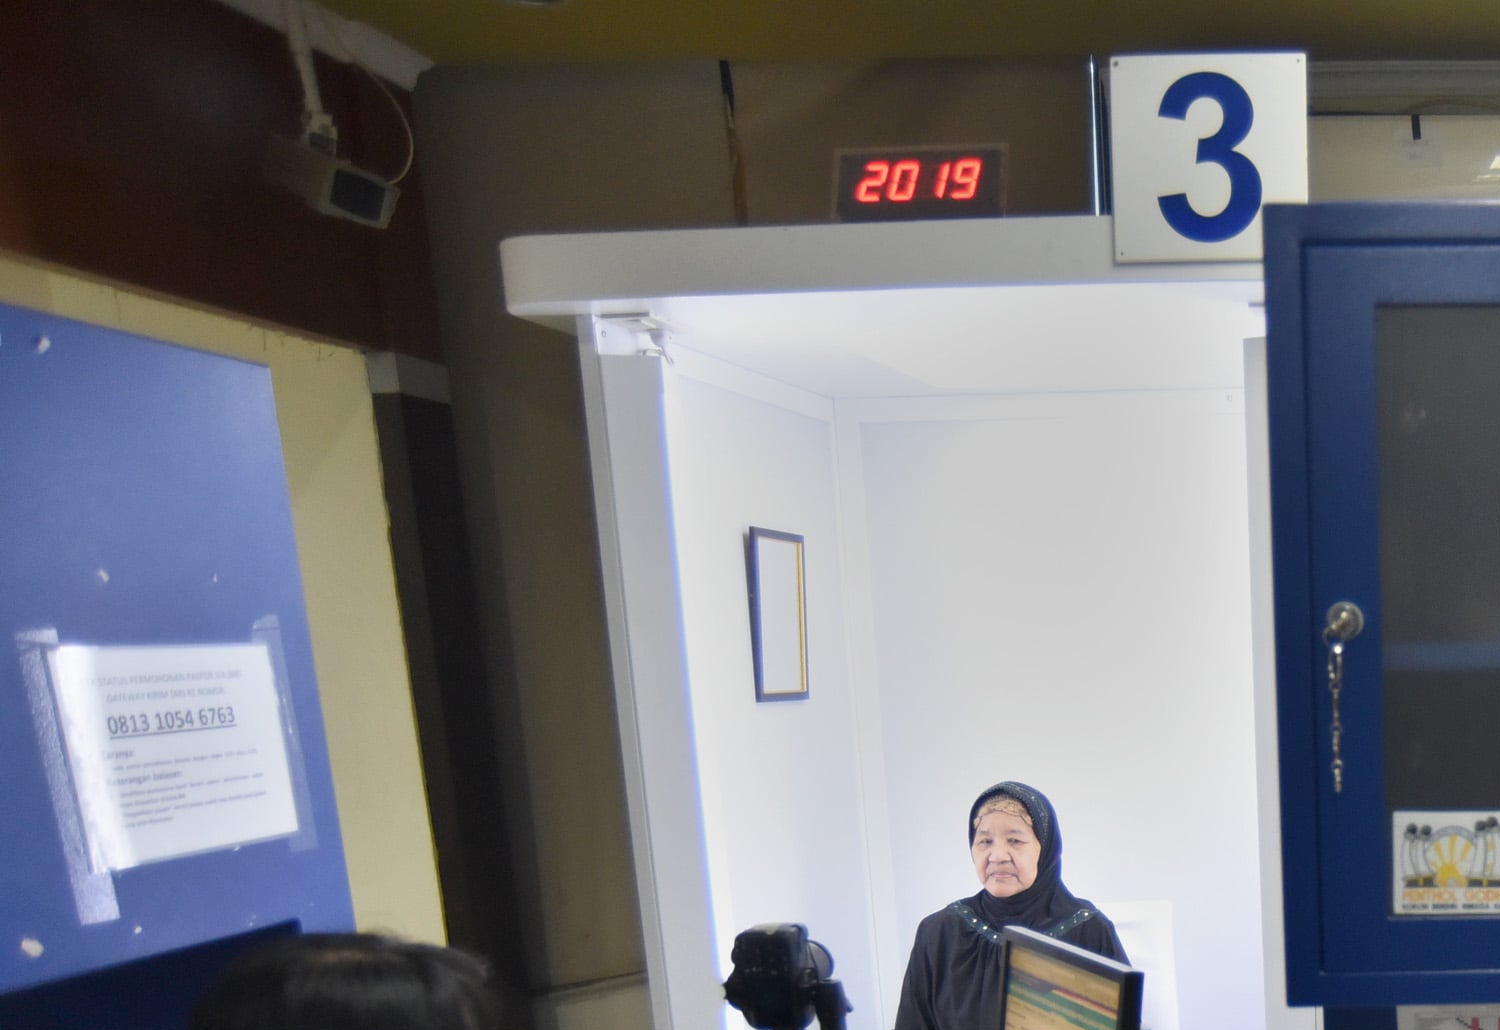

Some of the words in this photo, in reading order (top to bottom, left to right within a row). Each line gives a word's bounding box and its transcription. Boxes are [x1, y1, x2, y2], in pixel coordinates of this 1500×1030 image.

[855, 157, 983, 203] 2019
[1157, 71, 1263, 243] 3
[107, 713, 150, 735] 0813
[155, 709, 194, 731] 1054
[199, 706, 236, 725] 6763
